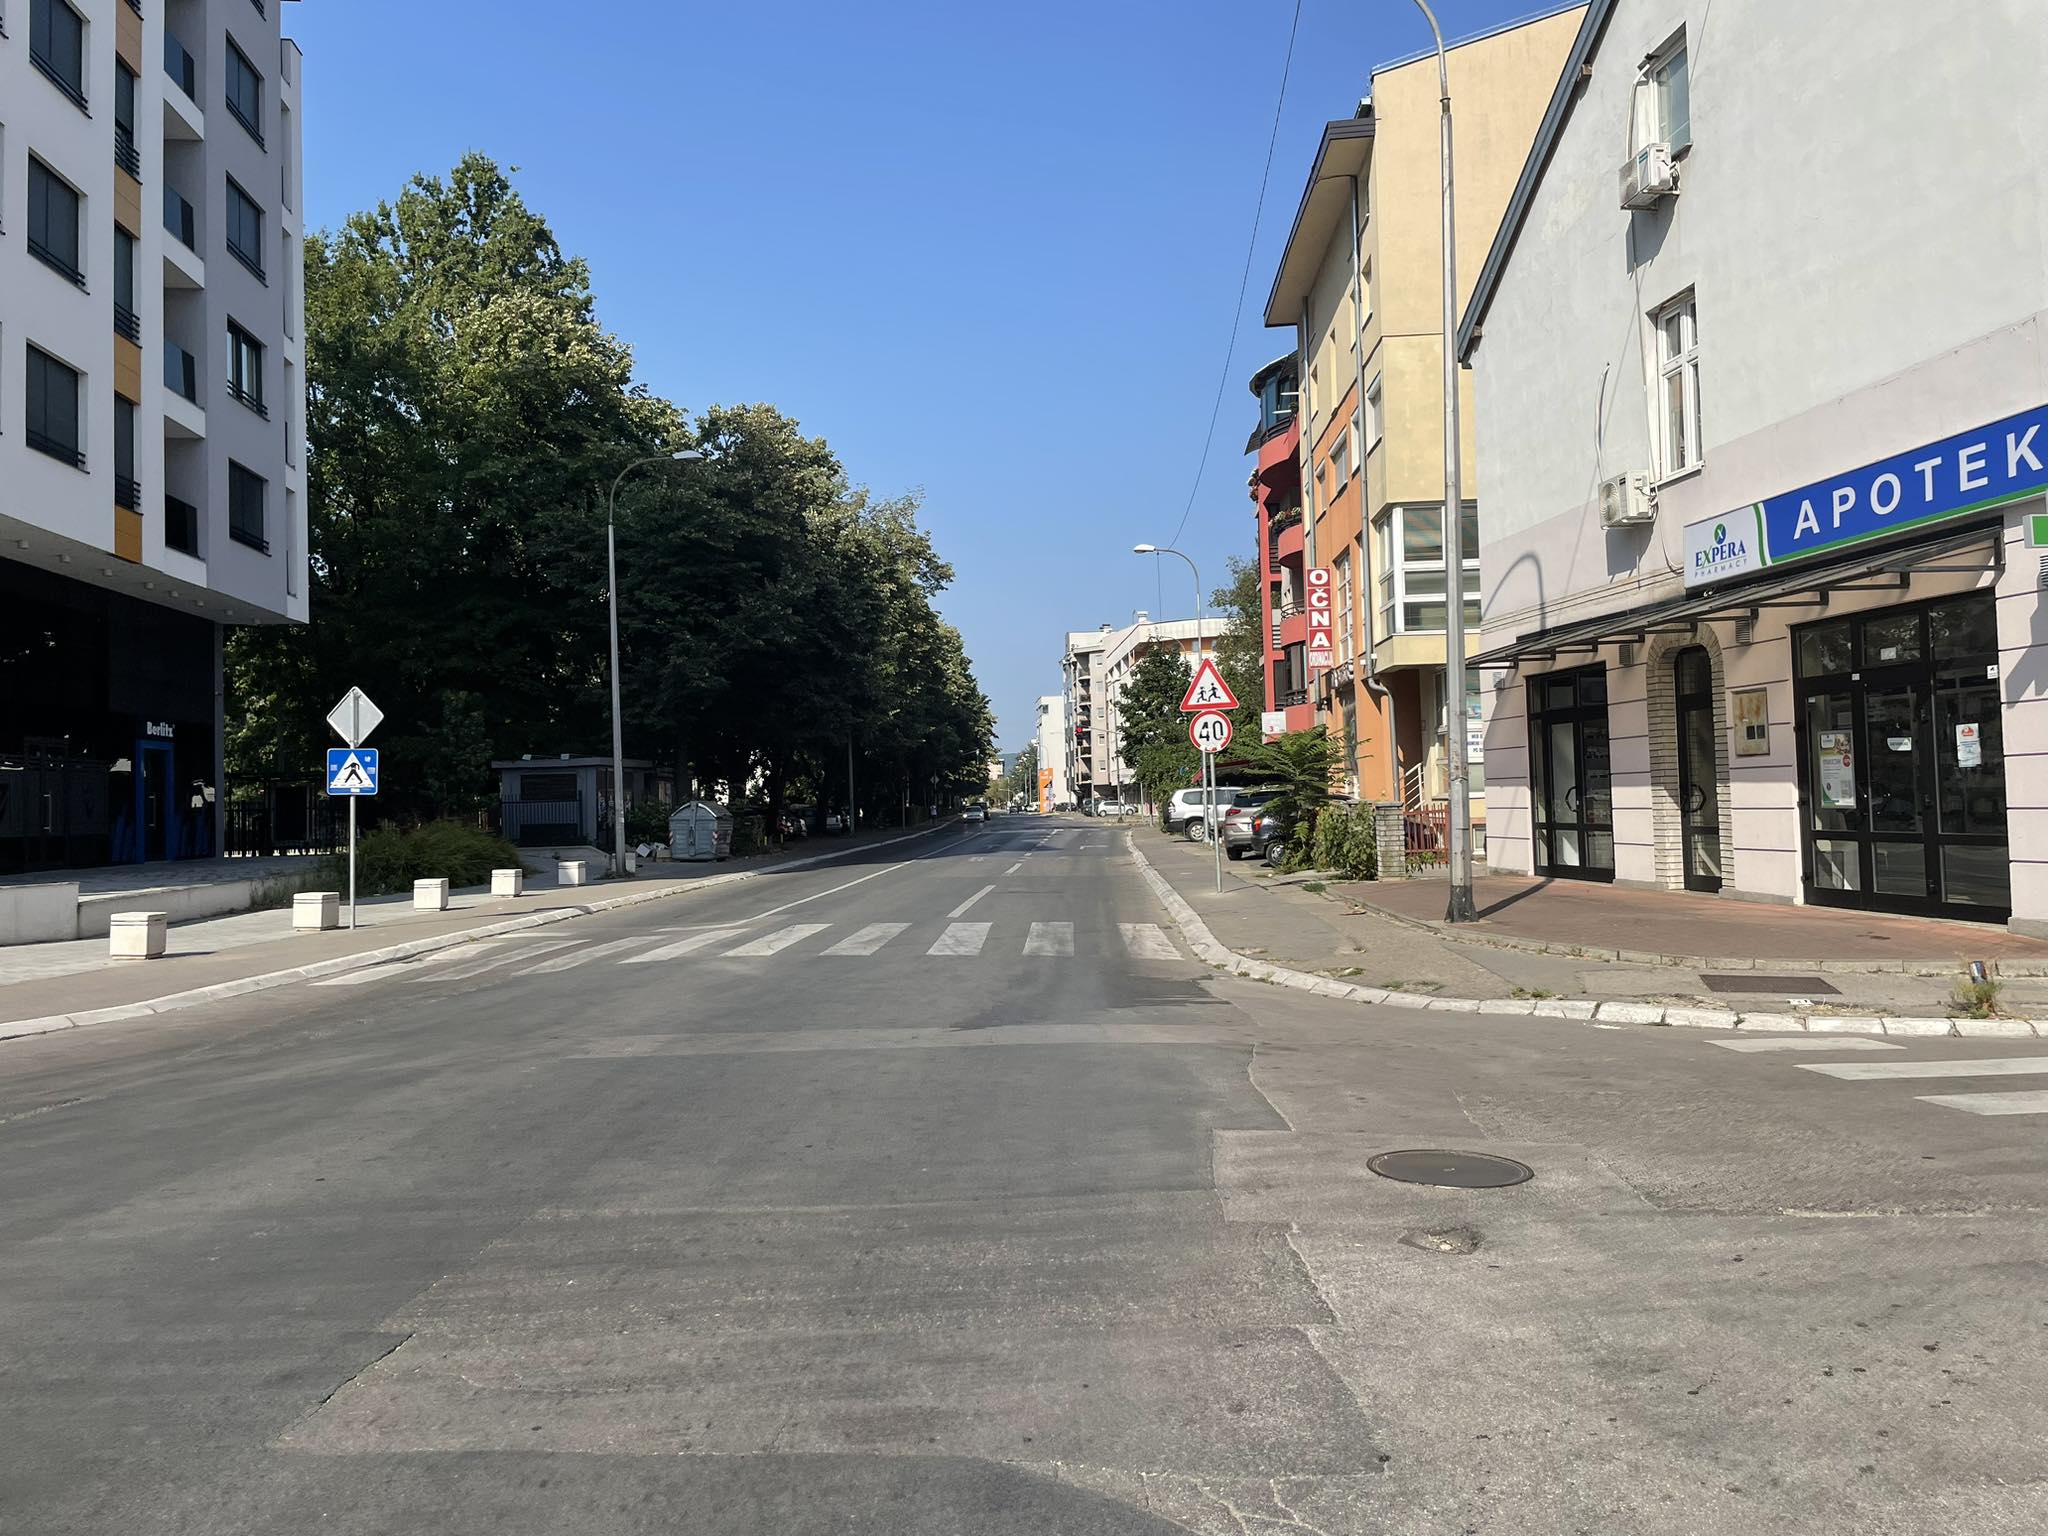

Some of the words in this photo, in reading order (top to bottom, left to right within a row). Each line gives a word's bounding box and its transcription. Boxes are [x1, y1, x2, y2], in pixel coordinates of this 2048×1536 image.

[1792, 423, 2045, 541] APOTEK
[1695, 539, 1747, 569] EXPERA
[1694, 558, 1748, 579] PHARMACY
[1309, 569, 1331, 648] OČNA
[146, 720, 174, 738] Berlitz
[1198, 720, 1224, 742] 40
